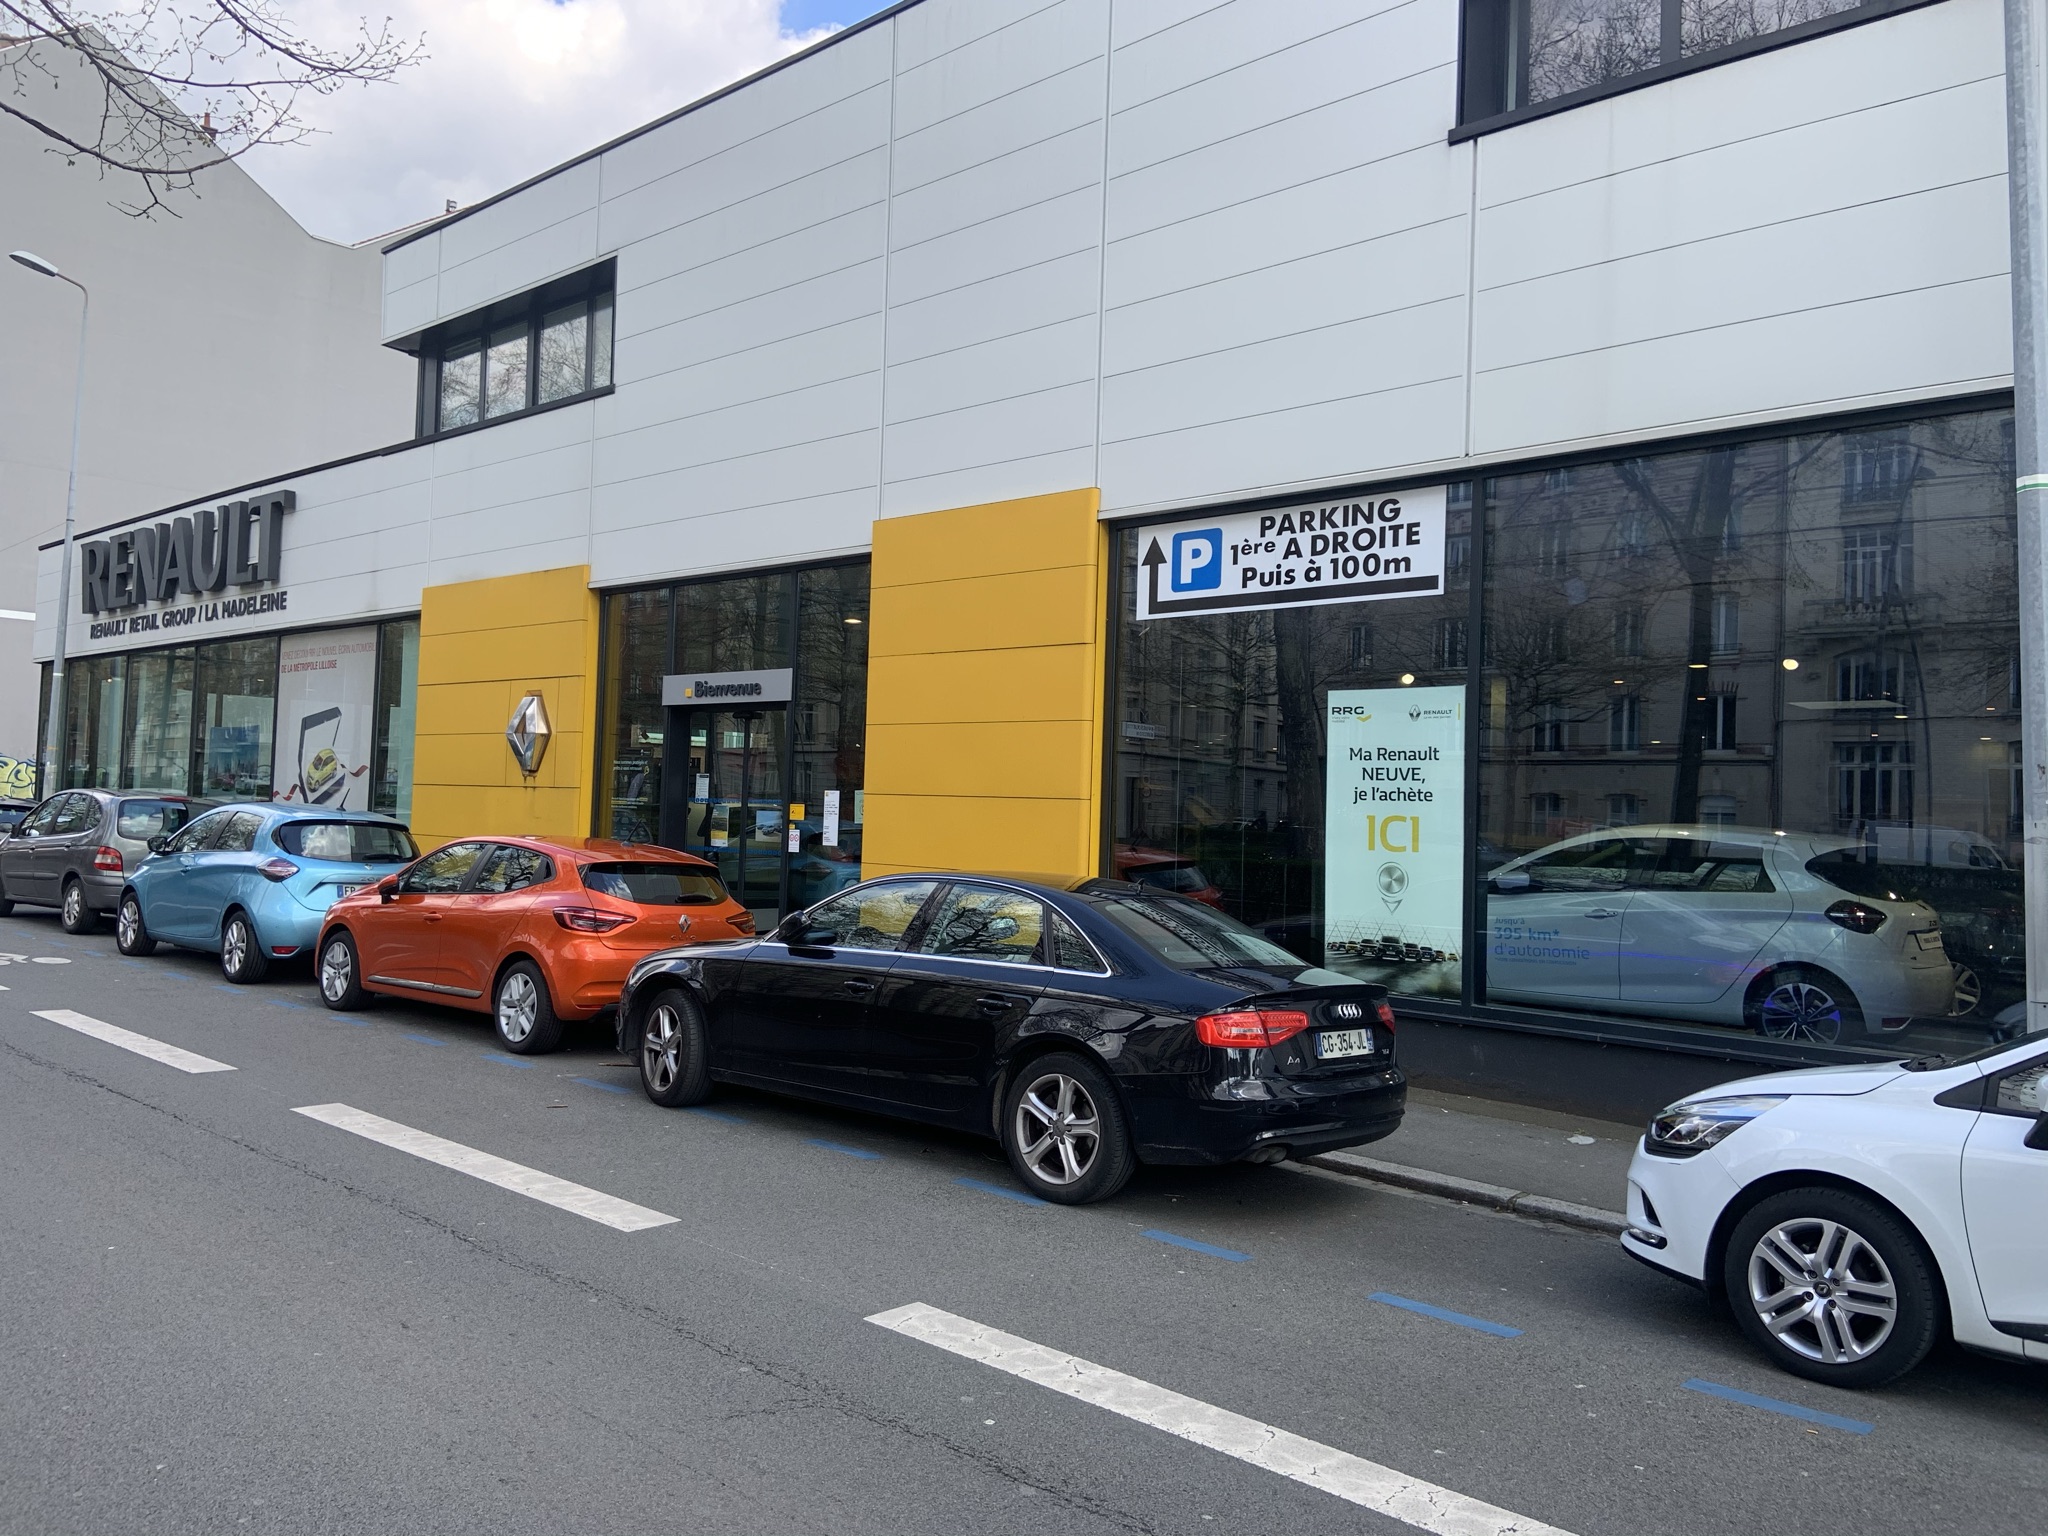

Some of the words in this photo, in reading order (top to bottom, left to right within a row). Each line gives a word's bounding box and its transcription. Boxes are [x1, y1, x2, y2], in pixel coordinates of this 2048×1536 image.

[1259, 498, 1402, 538] PARKING
[81, 490, 296, 614] RENAULT
[1230, 538, 1277, 566] 1ère
[1282, 537, 1304, 560] A
[1310, 522, 1421, 557] DROITE
[1180, 538, 1213, 584] P
[1241, 562, 1296, 588] Puis
[1304, 558, 1323, 582] à
[1329, 554, 1412, 580] 100m
[90, 618, 128, 640] RENAULT
[129, 613, 160, 634] RETAIL
[161, 608, 196, 629] GROUP
[204, 604, 219, 622] LA
[222, 591, 288, 619] MADELEINE
[694, 680, 762, 699] Bienvenue
[1331, 706, 1365, 715] RRG
[1349, 747, 1372, 761] Ma
[1377, 746, 1439, 761] Renault
[1362, 767, 1425, 784] NEUVE,
[1353, 787, 1367, 804] je
[1372, 787, 1433, 802] l'achète
[1366, 815, 1420, 853] ICI
[1494, 927, 1522, 940] 395
[1494, 942, 1590, 960] d'autonomie
[1286, 1055, 1301, 1066] A4
